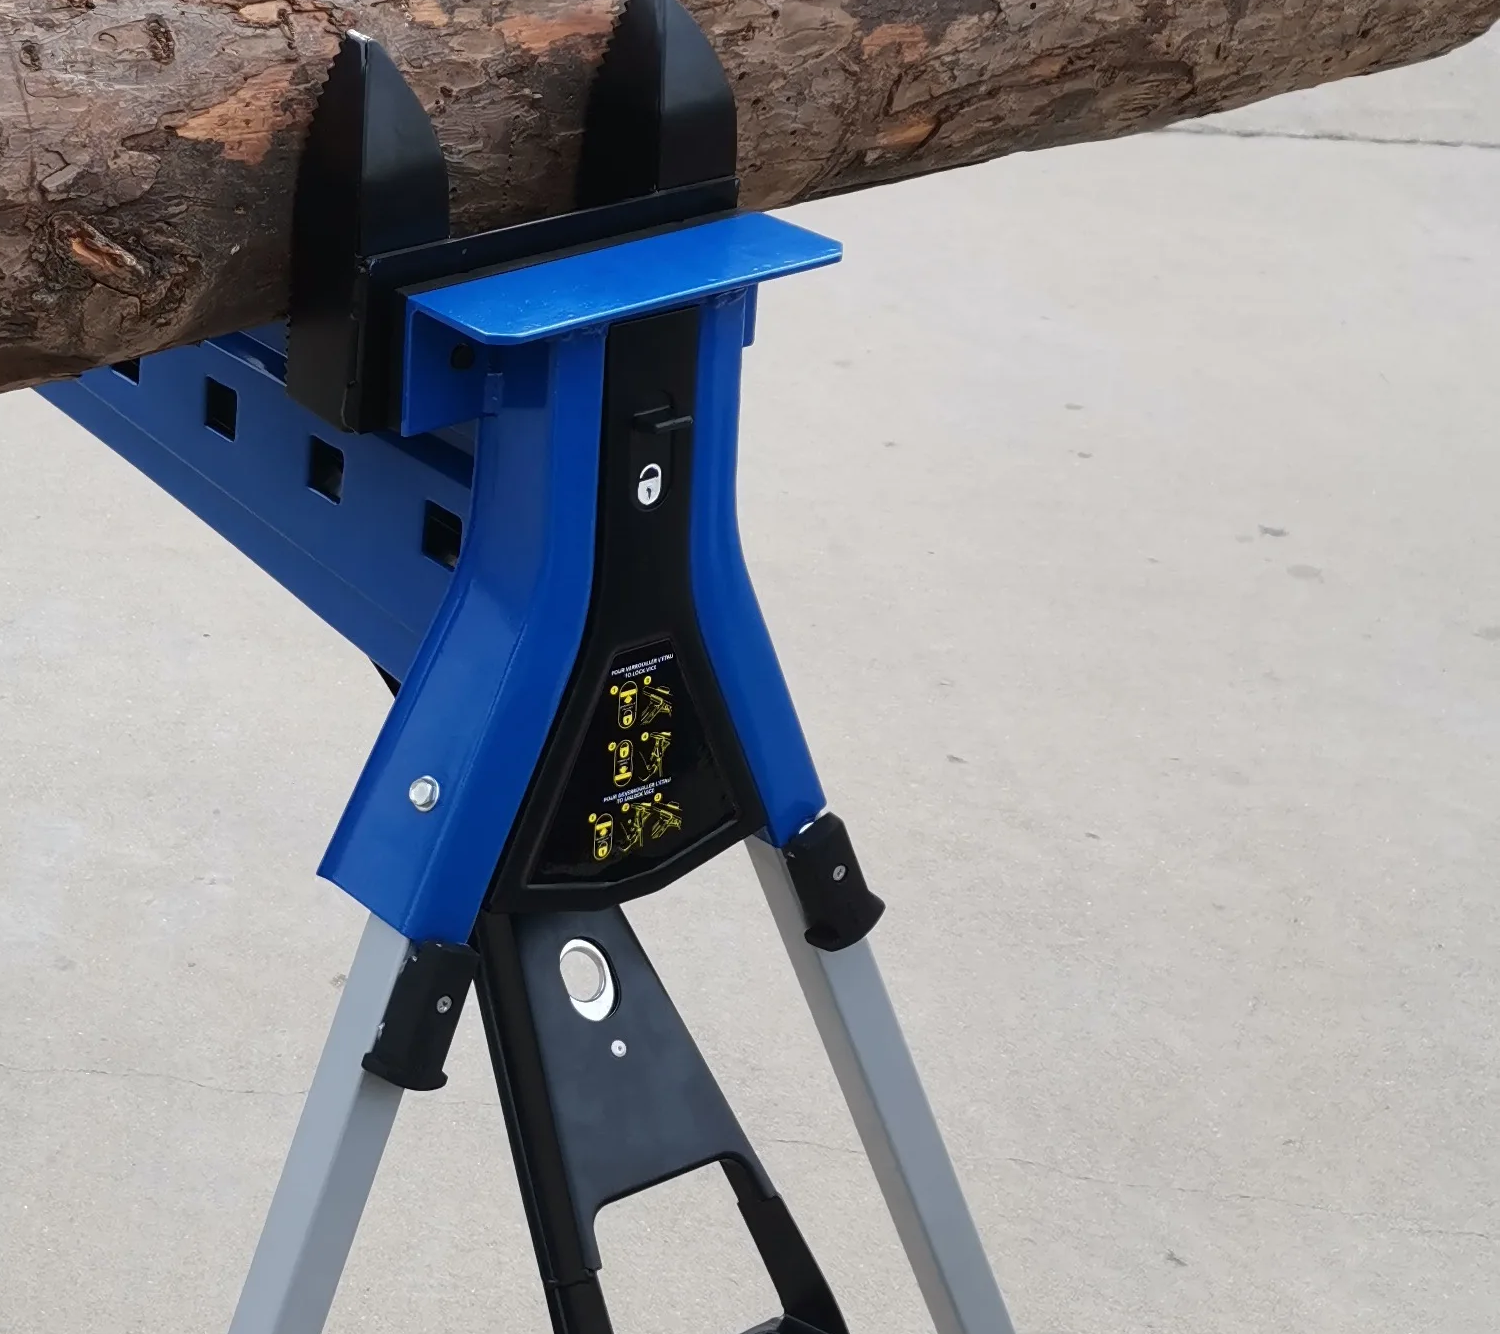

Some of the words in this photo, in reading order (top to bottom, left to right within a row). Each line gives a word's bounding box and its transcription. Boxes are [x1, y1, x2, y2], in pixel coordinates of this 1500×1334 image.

[611, 667, 625, 676] POUR
[632, 668, 646, 677] LOCK
[646, 664, 657, 672] VICE
[603, 794, 617, 803] POUR
[624, 791, 644, 802] UNLOCK
